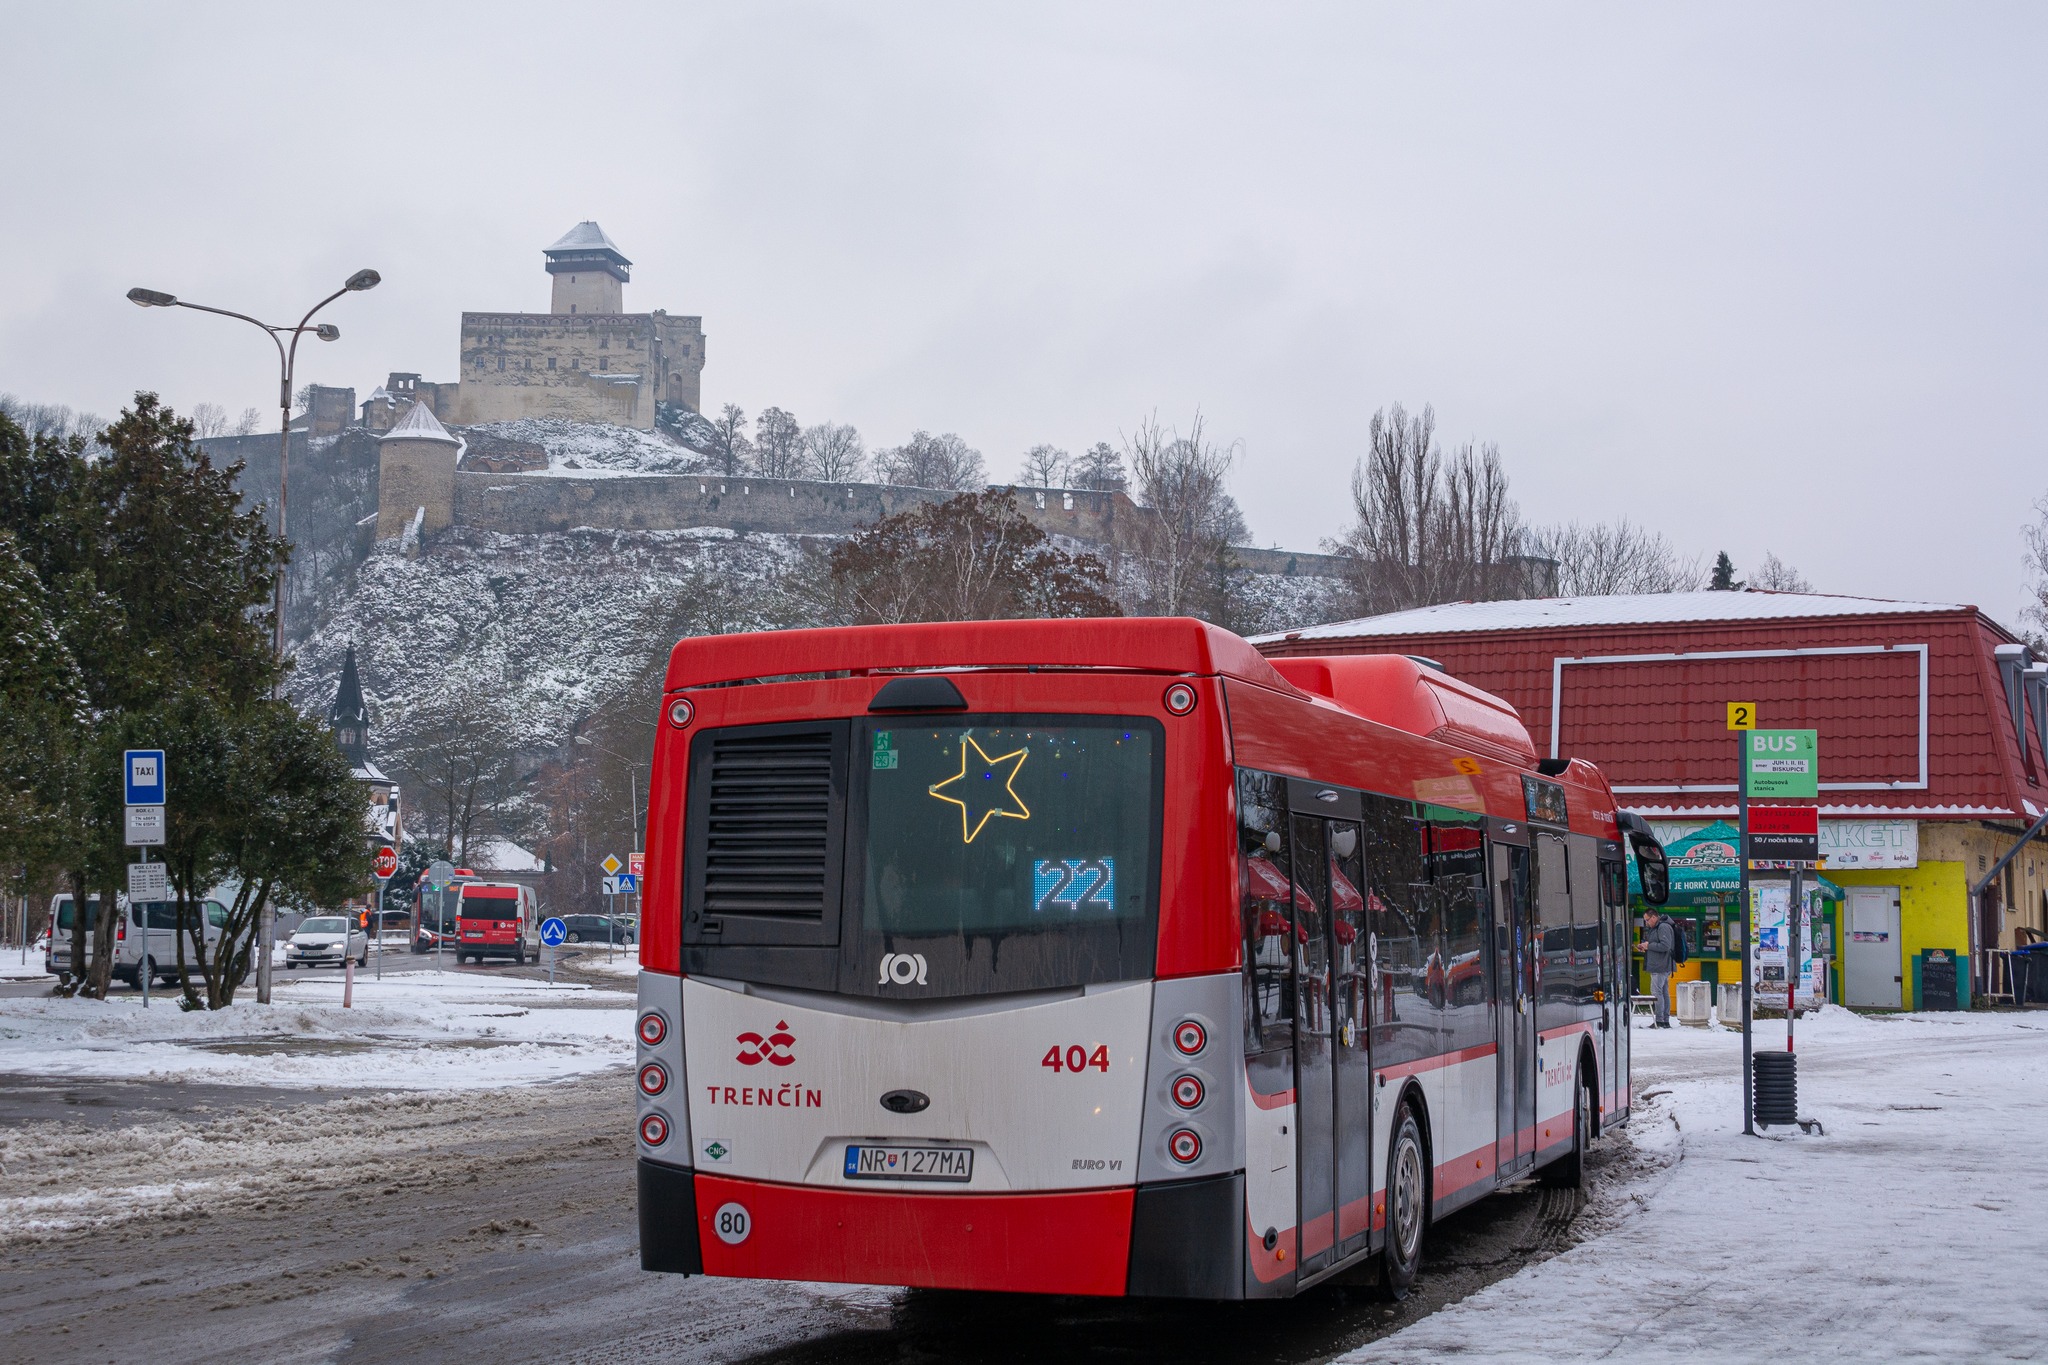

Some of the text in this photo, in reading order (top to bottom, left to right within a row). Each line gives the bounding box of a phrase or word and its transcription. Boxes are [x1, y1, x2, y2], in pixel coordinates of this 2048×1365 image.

[1734, 707, 1748, 726] 2
[1753, 735, 1797, 752] BUS
[135, 767, 154, 776] TAXI
[1818, 820, 1909, 847] AKEŤ
[1668, 857, 1740, 867] RADEGAS
[1038, 860, 1110, 909] 22
[1674, 881, 1682, 889] JE
[1684, 880, 1709, 889] HORKÝ.
[1711, 880, 1740, 889] VĎAKAB
[1041, 1044, 1110, 1073] 404
[707, 1083, 821, 1107] TRENČÍN
[708, 1146, 724, 1155] CNG
[860, 1149, 966, 1174] NR 127MA
[1072, 1159, 1122, 1170] EURO VI
[720, 1212, 745, 1235] 80
